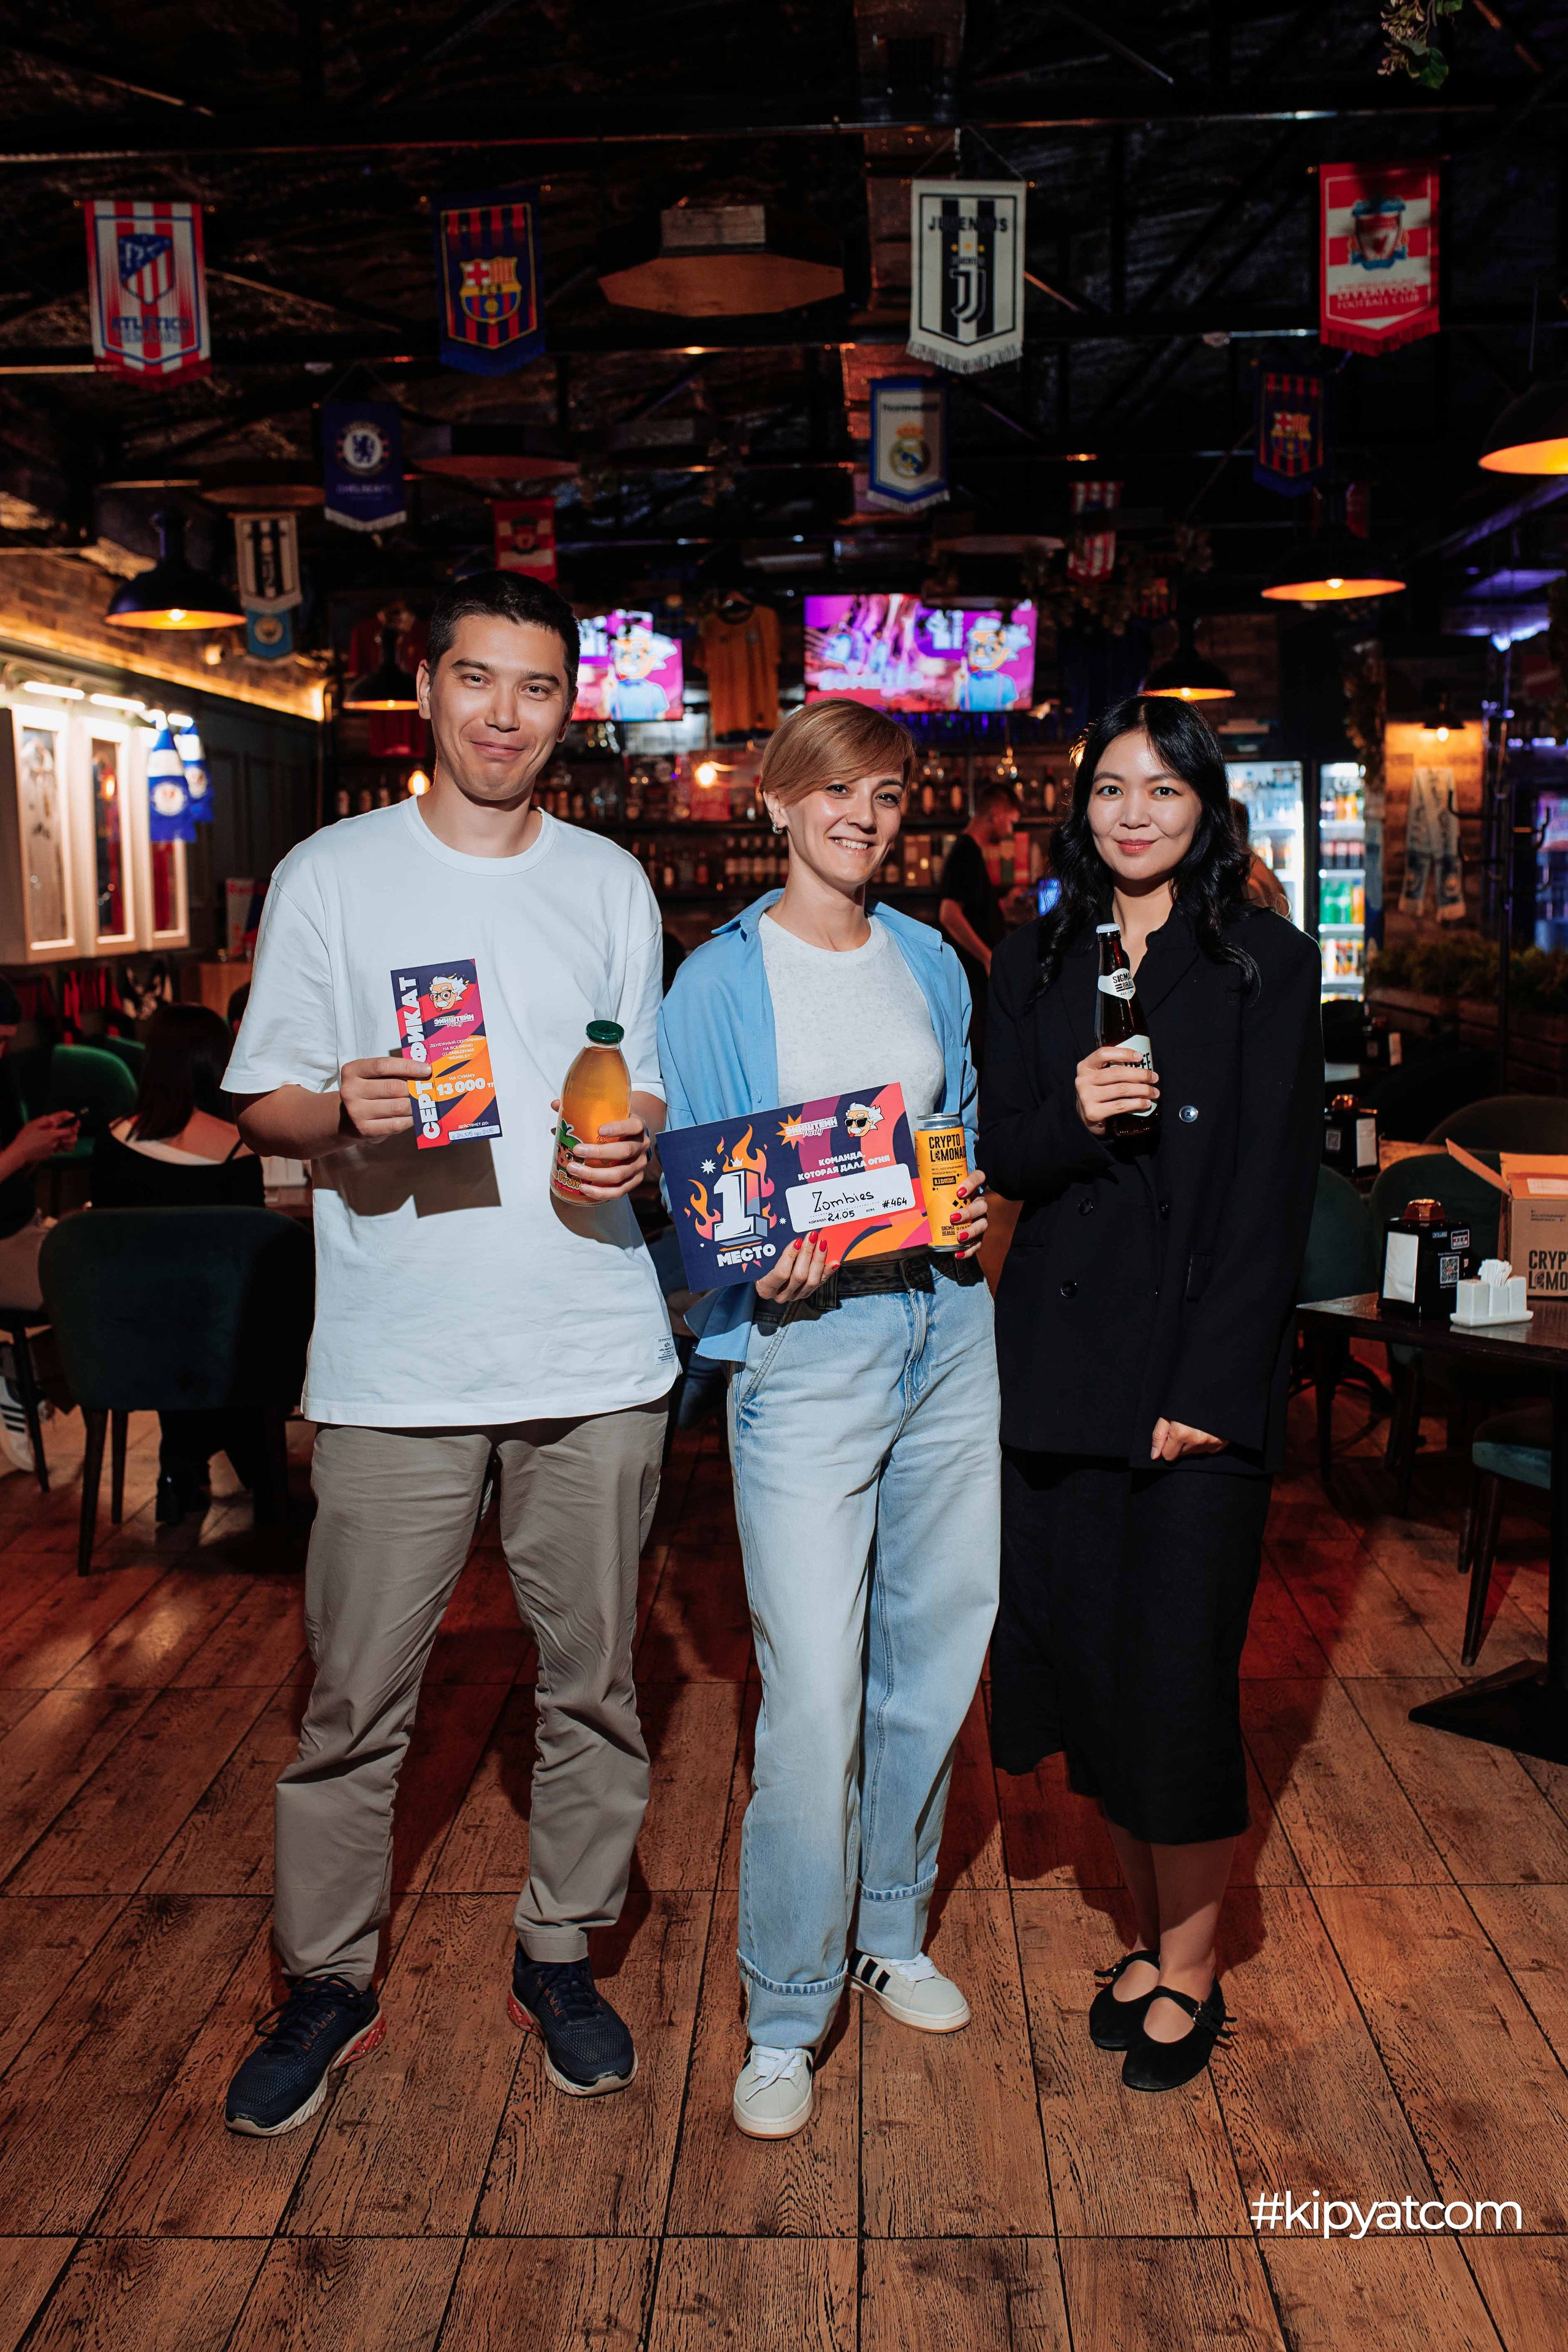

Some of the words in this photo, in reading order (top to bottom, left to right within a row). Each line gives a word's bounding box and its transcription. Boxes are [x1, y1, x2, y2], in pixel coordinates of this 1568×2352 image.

[1112, 972, 1133, 983] SIGMA
[399, 976, 440, 1139] СЕРТФИКАТ
[436, 1084, 453, 1096] 13
[454, 1077, 486, 1093] 000
[929, 1134, 960, 1148] CRYPTO
[798, 1167, 839, 1180] КОТОРАЯ
[840, 1159, 867, 1173] ДАЛА
[868, 1155, 890, 1166] ОГНЯ
[819, 1151, 865, 1166] КОМАНДА,
[559, 1170, 581, 1188] Fruit
[812, 1191, 874, 1213] Zombies
[882, 1197, 907, 1209] #464
[827, 1210, 855, 1221] 21.05
[717, 1243, 776, 1267] МЕСТО
[1529, 1250, 1568, 1270] CRYP
